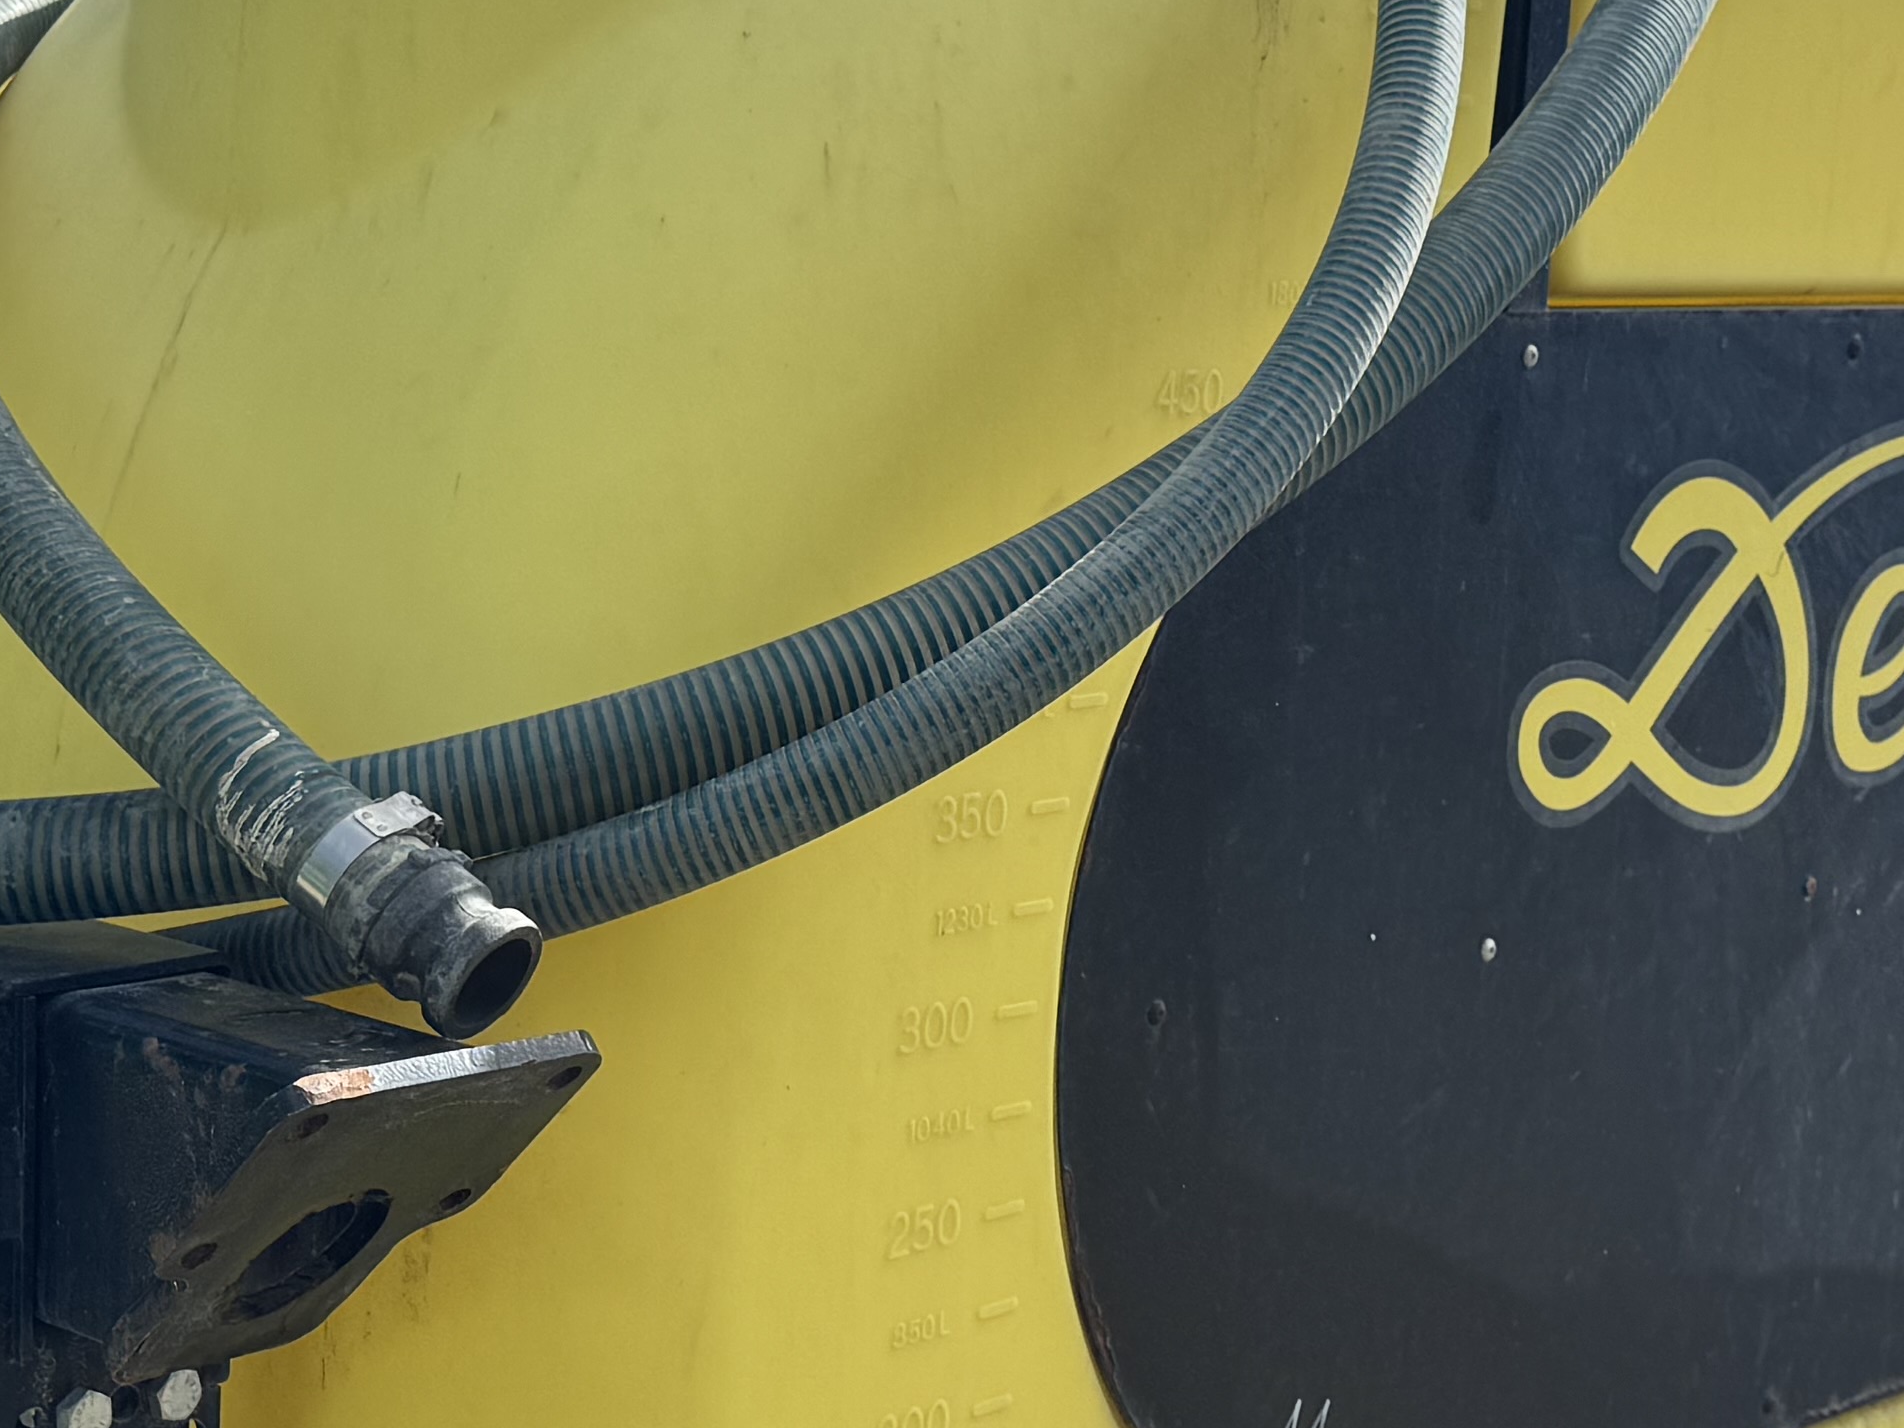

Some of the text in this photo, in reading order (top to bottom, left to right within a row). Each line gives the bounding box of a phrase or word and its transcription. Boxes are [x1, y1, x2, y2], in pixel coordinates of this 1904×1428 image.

[1157, 368, 1223, 414] 450
[936, 789, 1008, 842] 350
[899, 996, 973, 1054] 300
[887, 1198, 962, 1260] 250
